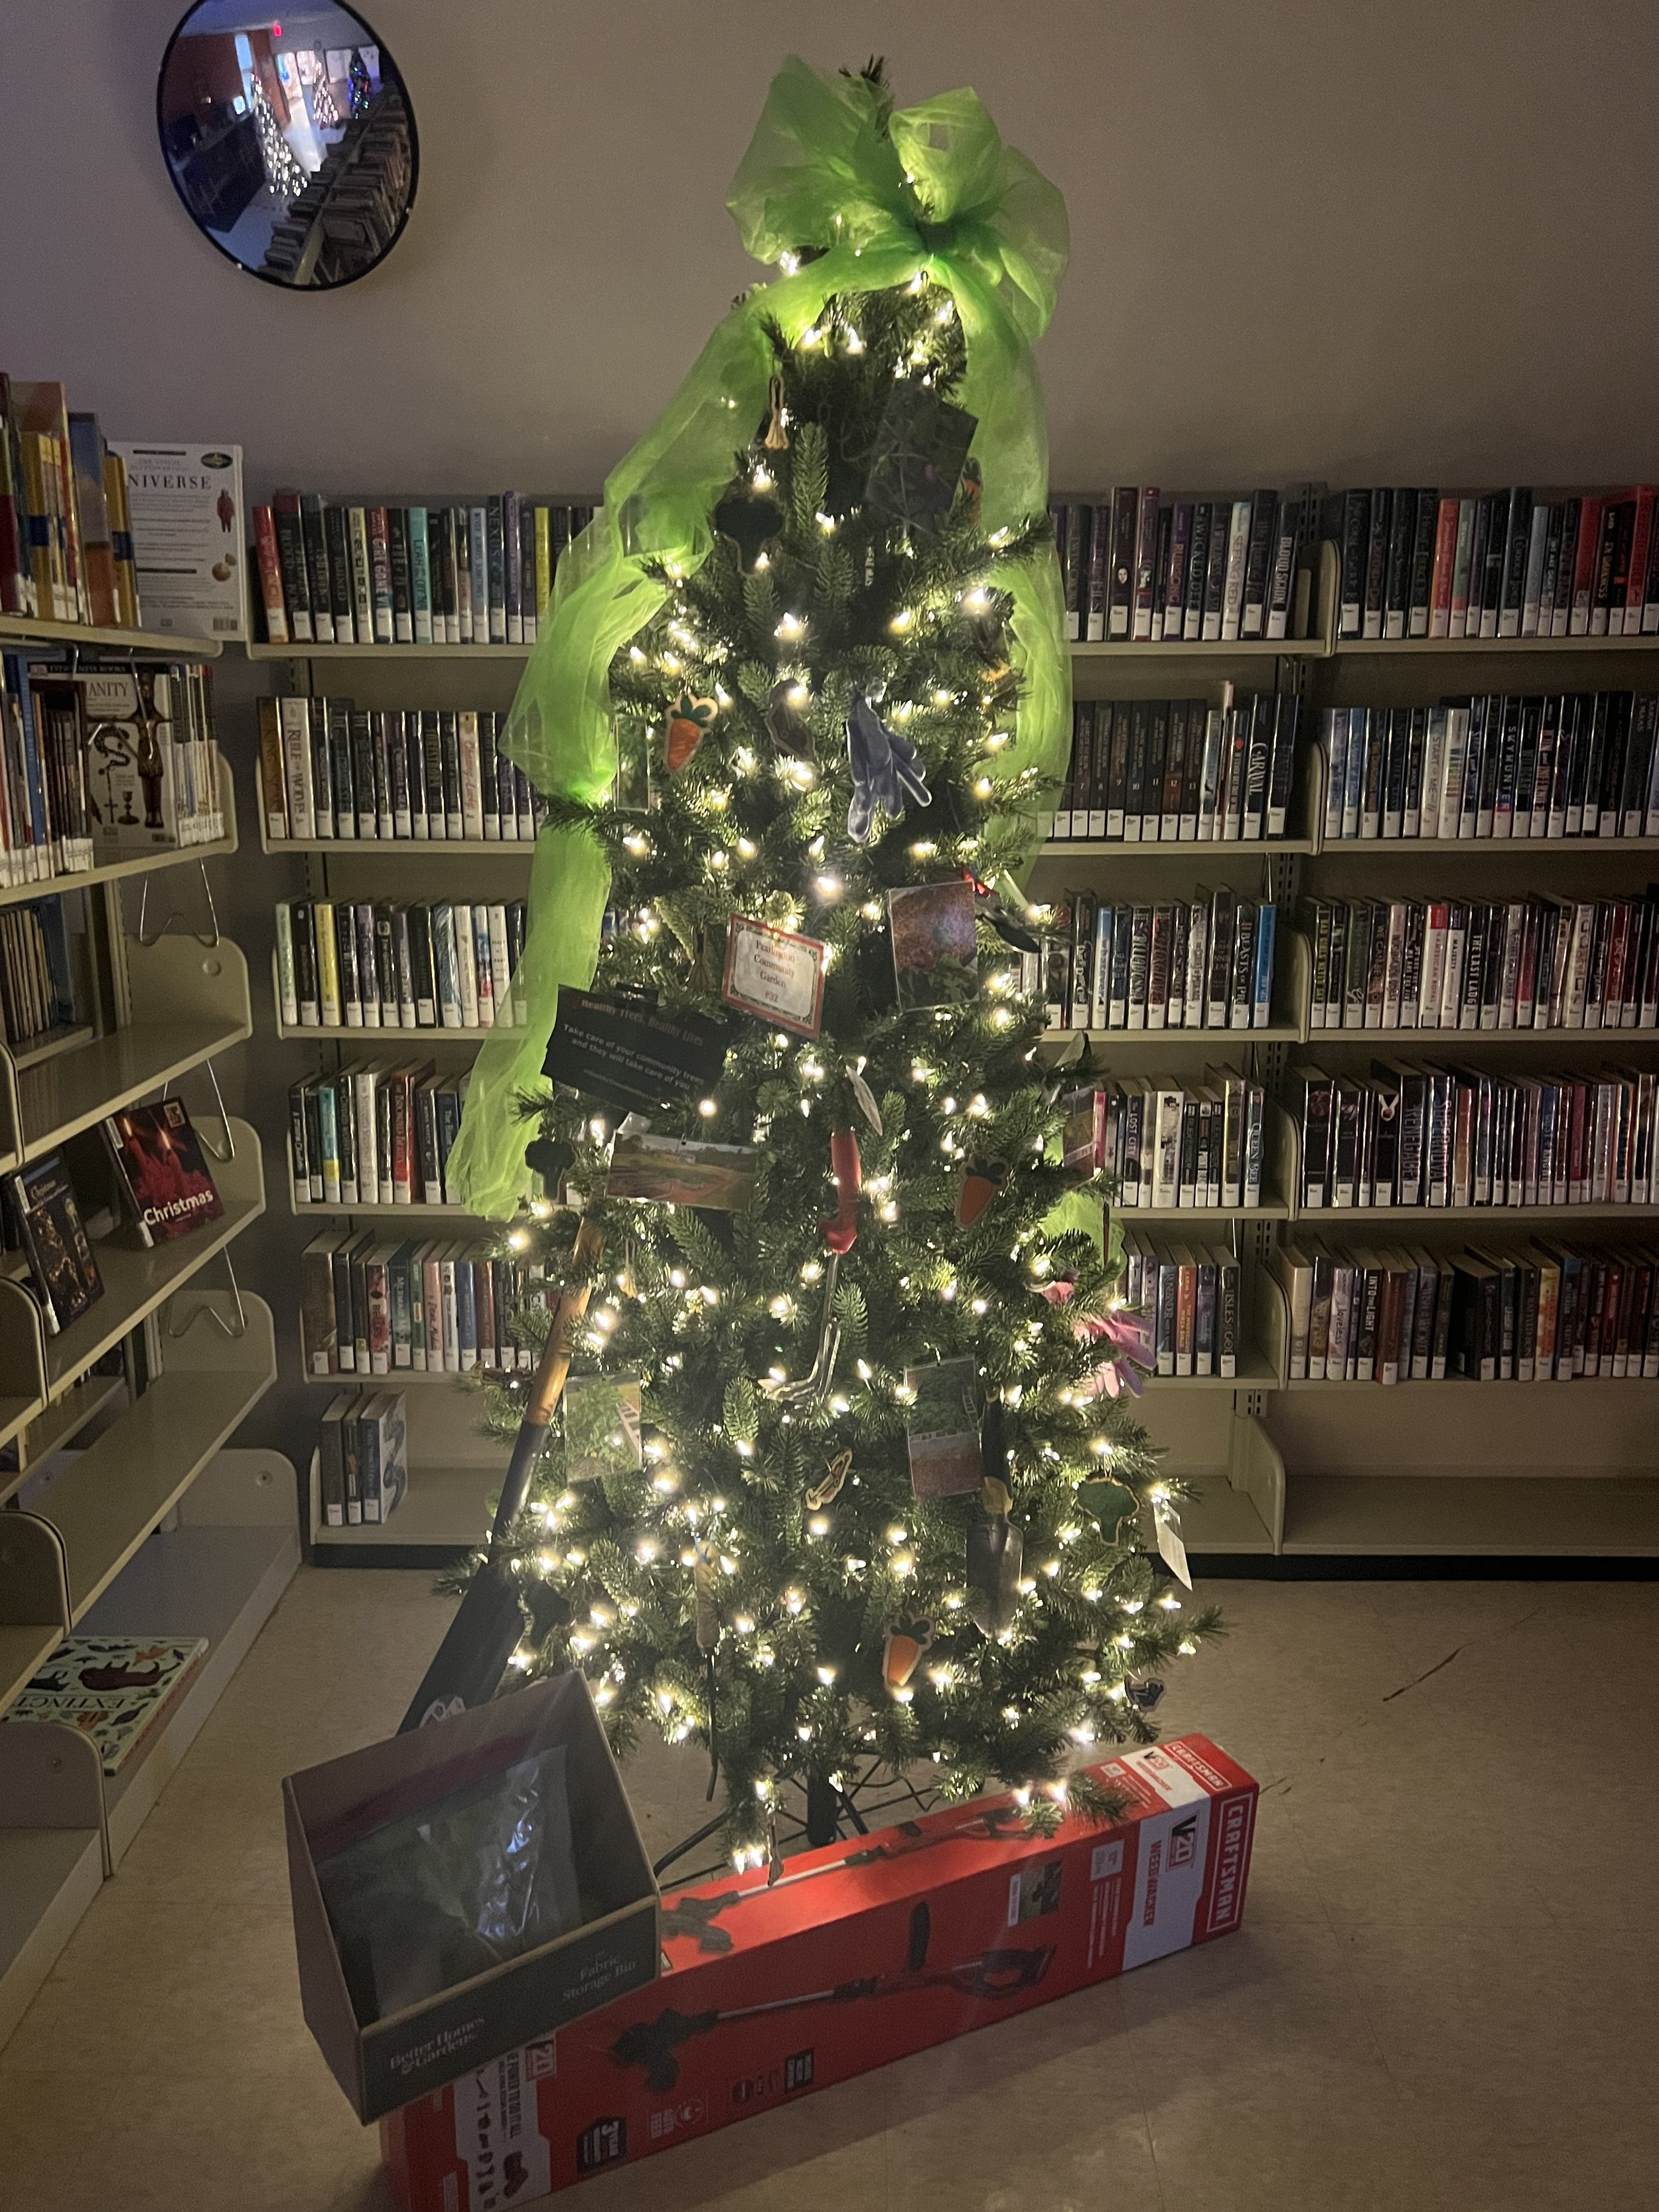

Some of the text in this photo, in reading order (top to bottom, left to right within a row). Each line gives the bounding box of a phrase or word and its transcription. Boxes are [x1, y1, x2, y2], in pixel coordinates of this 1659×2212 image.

[128, 474, 212, 489] NIVERSE
[488, 506, 500, 557] NEXUS
[372, 538, 386, 563] GIRL
[1189, 522, 1207, 609] WICKED DEE
[1226, 535, 1244, 606] SEEING RED
[1273, 572, 1289, 605] SCION
[286, 584, 299, 611] BON
[89, 682, 129, 697] ANITY
[287, 729, 302, 760] RULE
[1248, 741, 1269, 796] CARAVAL
[1429, 736, 1441, 793] START ME
[1499, 725, 1517, 810] SKYHUNTER
[397, 794, 406, 810] DEA
[1376, 925, 1384, 938] WE
[754, 954, 796, 978] Community
[1237, 932, 1252, 974] BEASTS
[1450, 938, 1459, 970] MAJESTY
[1467, 934, 1483, 1004] THE LAST LAUG
[760, 970, 786, 988] Garden
[581, 999, 616, 1016] Healthy
[563, 1023, 705, 1086] Take care of your community trees
[571, 1037, 691, 1091] and they will take care of you
[1129, 1112, 1139, 1134] LOST
[1429, 1099, 1453, 1180] SUPERNOVA
[1128, 1136, 1137, 1156] CITY
[1248, 1122, 1262, 1183] QUEEN BEE
[1402, 1108, 1421, 1181] RENEGADE
[143, 1190, 214, 1226] Christmas
[1163, 1273, 1175, 1319] RUNEBINDER
[1367, 1275, 1378, 1295] INTO
[373, 1304, 384, 1339] BELLES
[1224, 1293, 1235, 1355] ISLES GOD
[1334, 1309, 1350, 1345] loveless
[1364, 1306, 1376, 1332] LIGHT
[1172, 1815, 1198, 1864] V20
[1216, 1805, 1244, 1921] CRAFTSMAN
[562, 1959, 636, 2002] Storage Bin
[580, 1954, 620, 1982] Fabric
[390, 2018, 486, 2071] Better Homes
[415, 2033, 476, 2067] Gardens
[601, 2120, 619, 2135] 3
